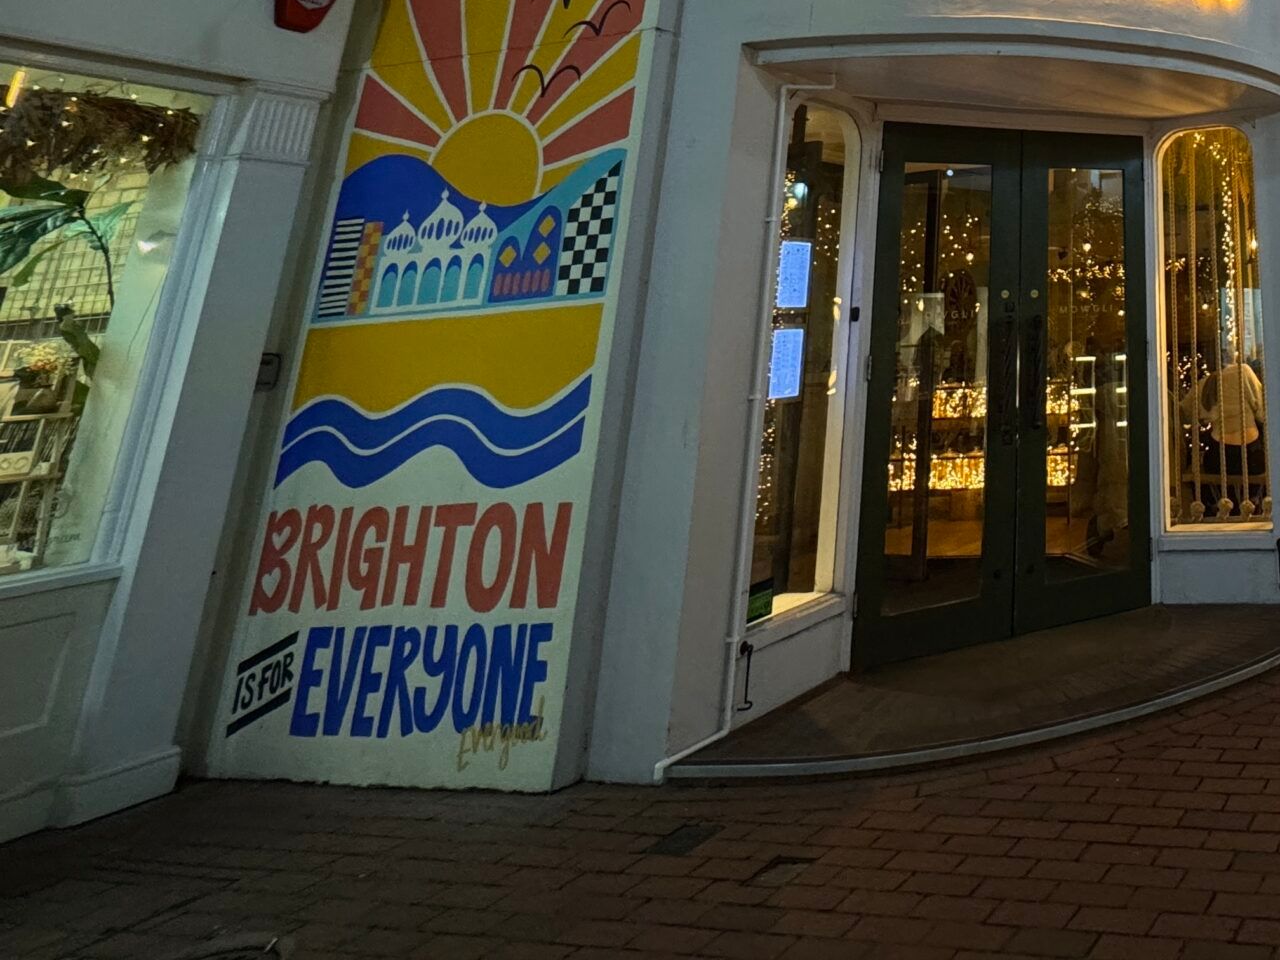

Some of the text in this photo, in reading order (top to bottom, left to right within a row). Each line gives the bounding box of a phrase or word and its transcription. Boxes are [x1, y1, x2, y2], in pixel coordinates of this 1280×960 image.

[1059, 304, 1113, 314] MOWGLI
[248, 502, 573, 617] BRIGHTON
[232, 651, 294, 715] IS FOR
[289, 622, 554, 739] EVERYONE
